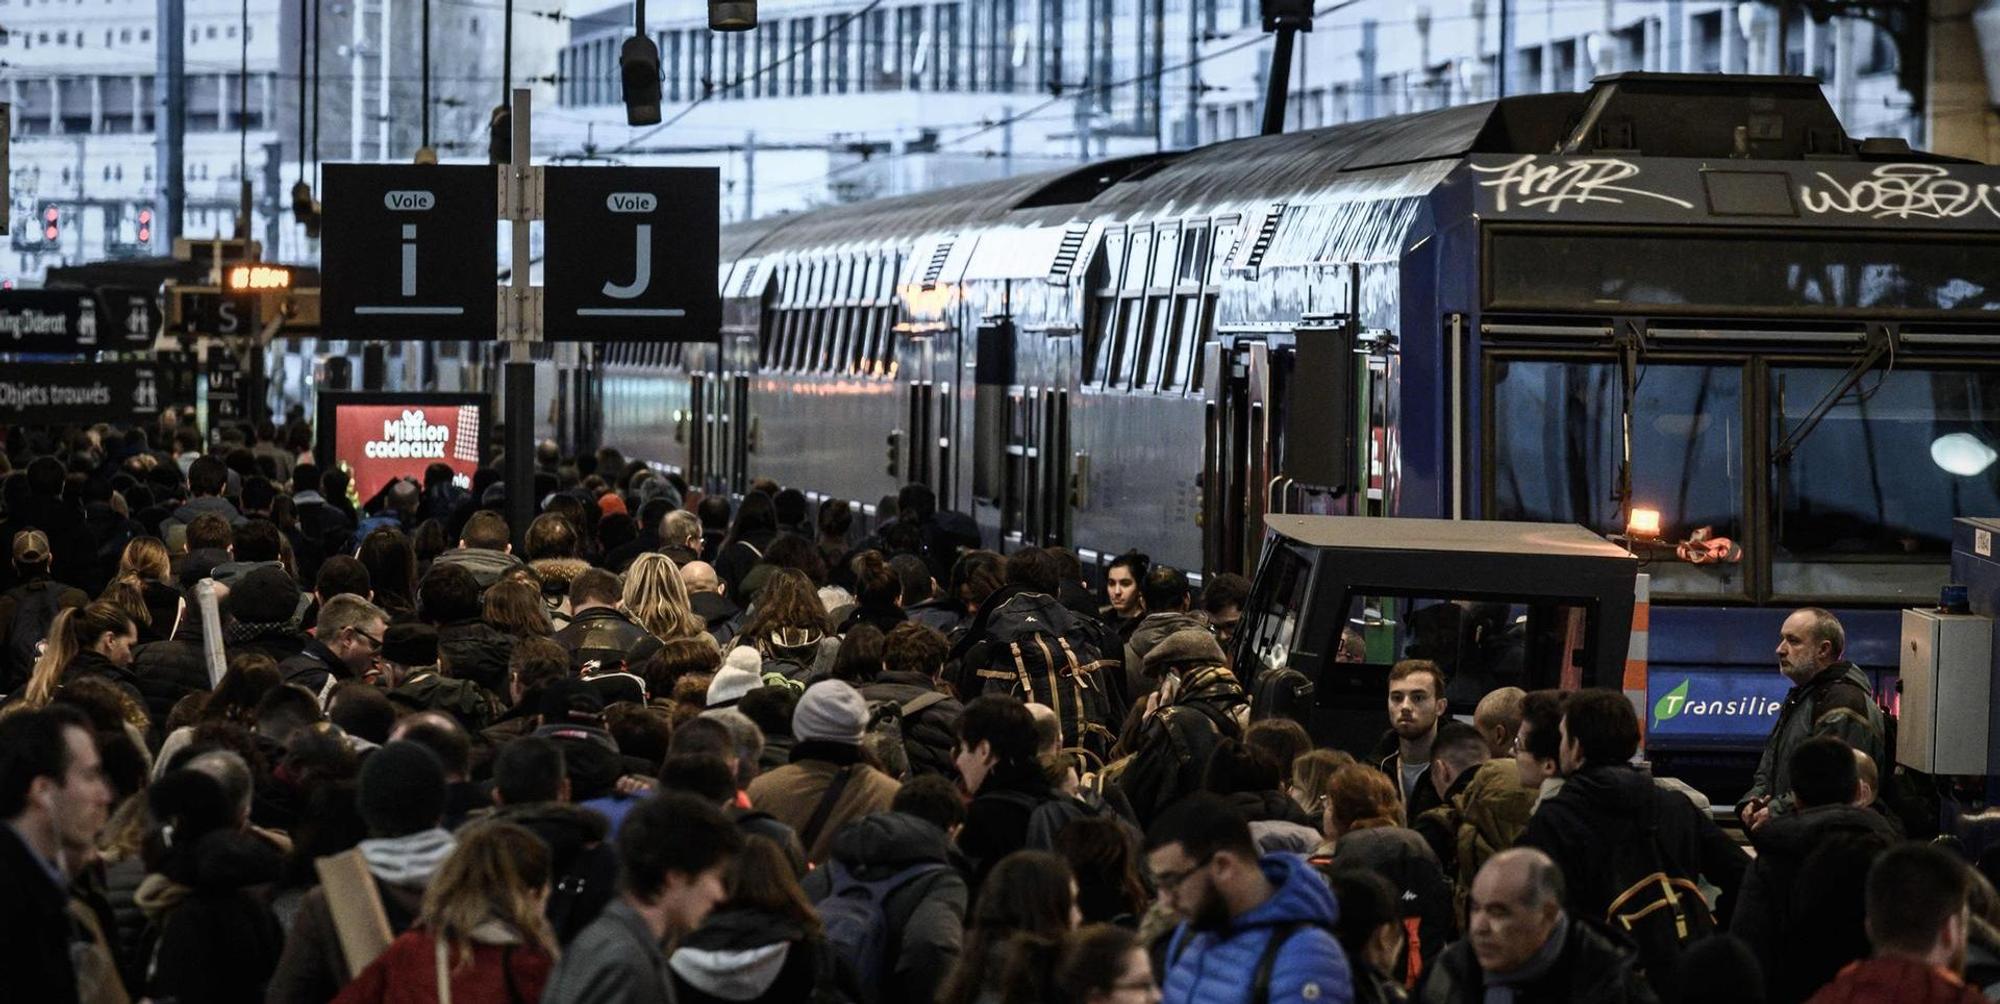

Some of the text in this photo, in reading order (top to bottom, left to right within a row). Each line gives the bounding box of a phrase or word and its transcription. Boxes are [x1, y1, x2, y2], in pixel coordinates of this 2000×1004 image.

[391, 194, 428, 208] Voie
[614, 196, 650, 210] Voie
[601, 224, 651, 299] J
[219, 302, 238, 332] S
[0, 381, 111, 411] Objets trouvés
[384, 419, 449, 441] Mission
[365, 436, 445, 459] cadeaux
[1667, 696, 1781, 715] Transilie
